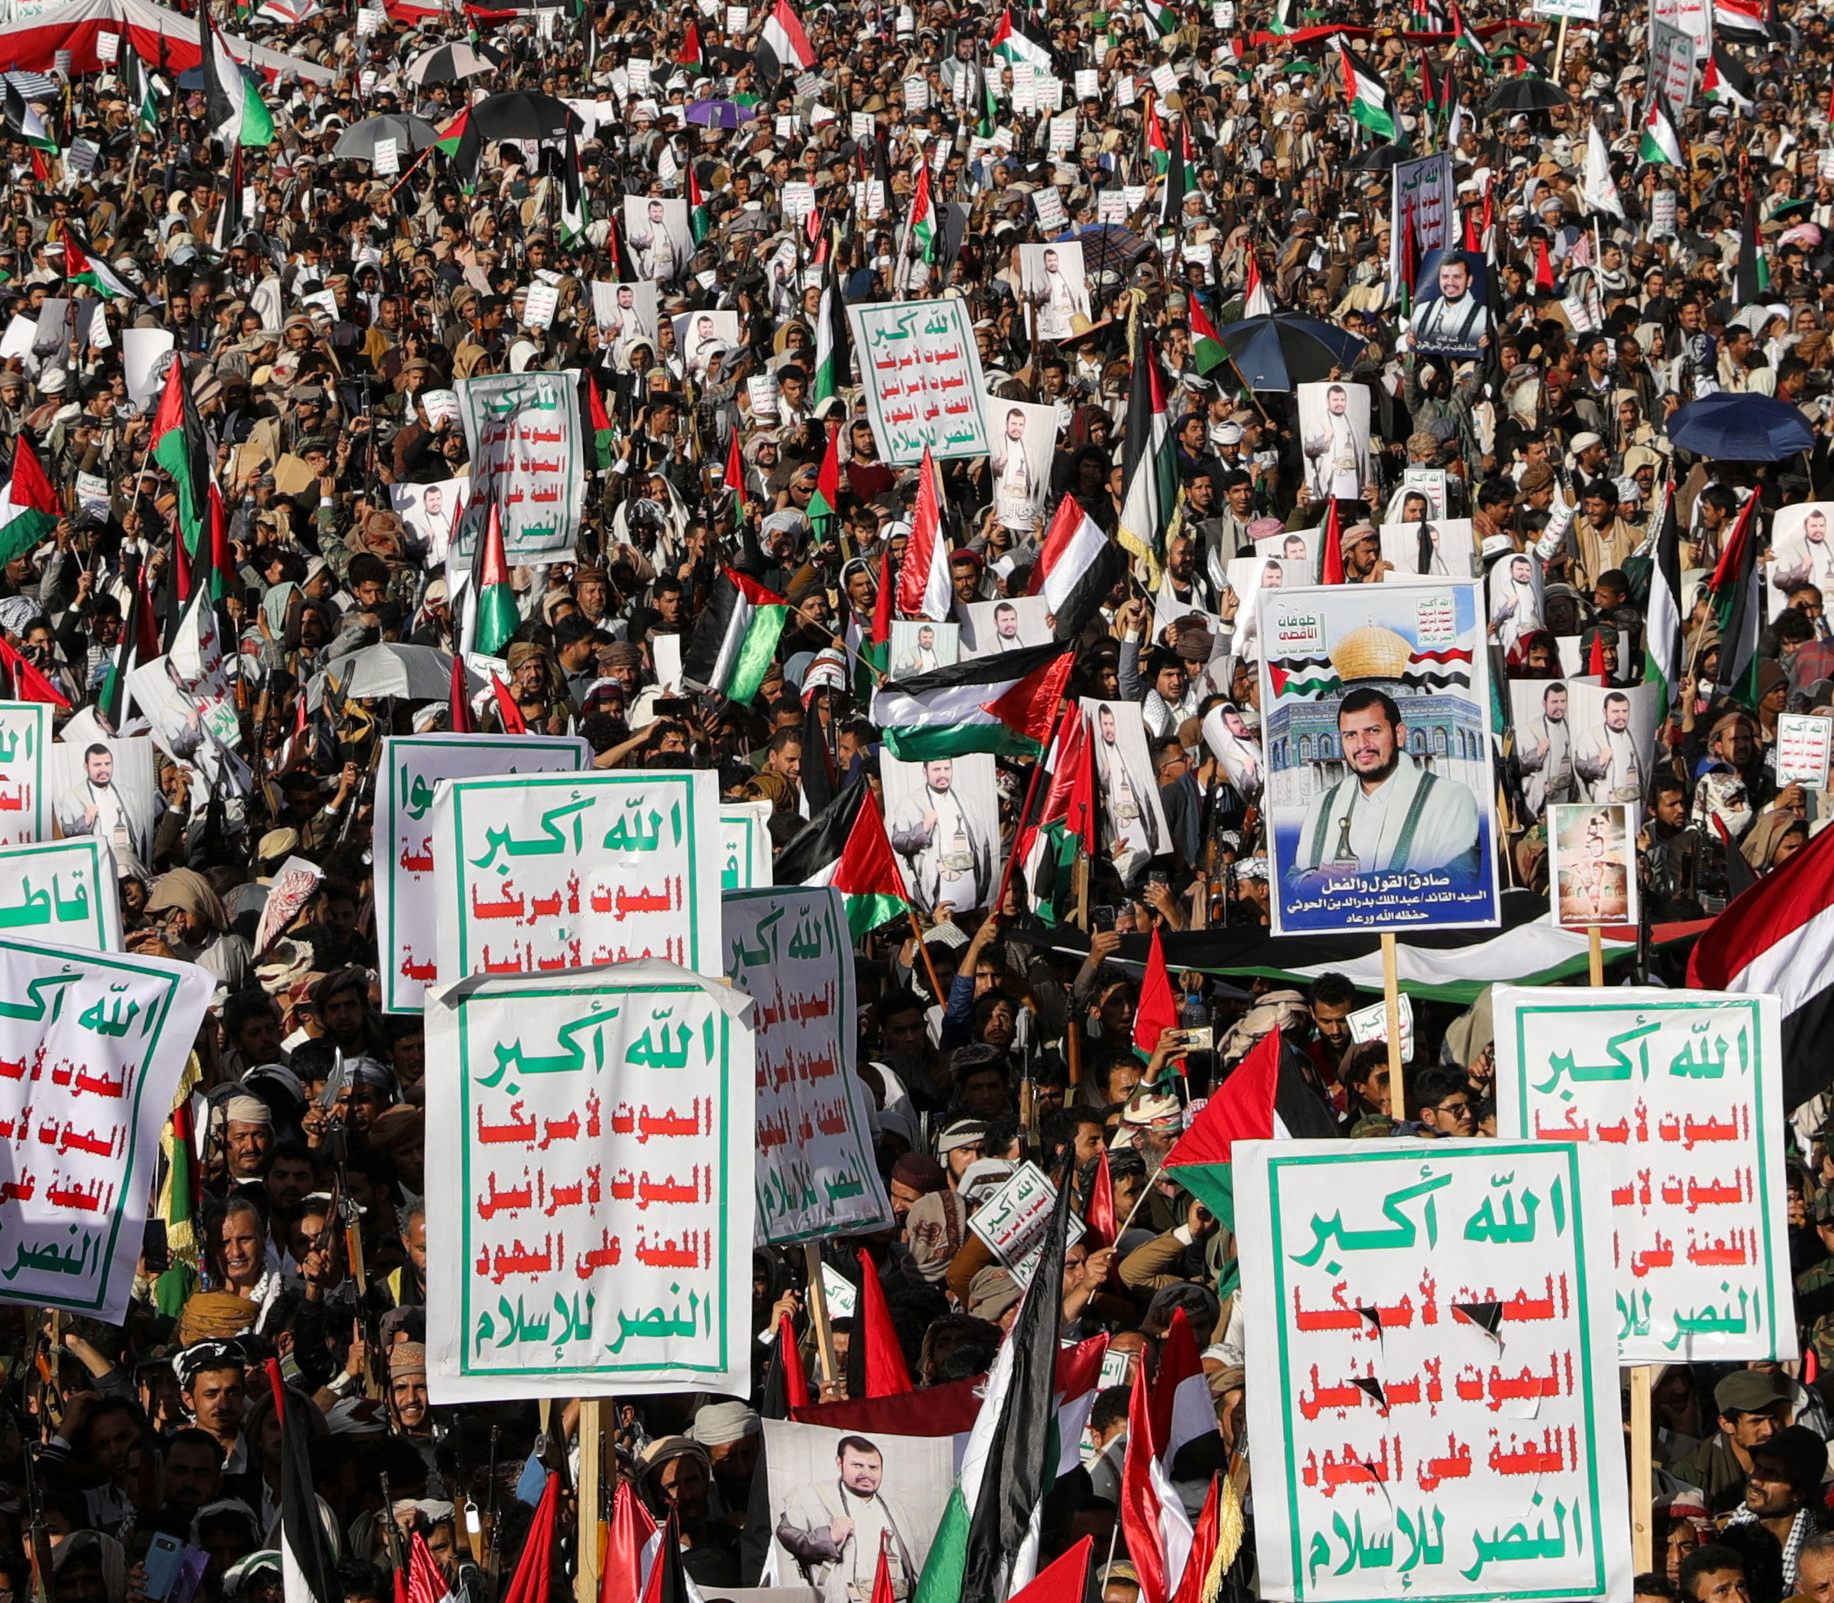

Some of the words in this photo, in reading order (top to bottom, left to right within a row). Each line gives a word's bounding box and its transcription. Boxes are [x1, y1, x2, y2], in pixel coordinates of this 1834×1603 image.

[1278, 614, 1317, 627] طوفان
[1279, 628, 1317, 641] الأقصى
[1287, 899, 1326, 913] الحوثي
[1322, 877, 1367, 894] والفعل
[1369, 875, 1407, 892] القول
[1409, 874, 1449, 890] صادق
[1458, 891, 1486, 902] السيد
[1376, 910, 1396, 920] الله
[1395, 910, 1428, 919] حفظه
[79, 986, 158, 1037] الله
[476, 1005, 619, 1095] أكبر
[625, 1009, 714, 1068] الله
[52, 1060, 133, 1098] الموت
[39, 1118, 125, 1157] الموت
[611, 1098, 711, 1143] الموت
[46, 1171, 113, 1212] اللعنة
[611, 1166, 711, 1210] الموت
[1464, 1173, 1565, 1243] الله
[1291, 1166, 1452, 1275] أكبر
[3, 1226, 105, 1280] النصر
[476, 1234, 564, 1284] اليهود
[576, 1229, 621, 1279] على
[636, 1226, 711, 1268] اللعنة
[476, 1294, 595, 1358] للإسلام
[607, 1283, 711, 1353] النصر
[1455, 1352, 1573, 1411] الموت
[1302, 1436, 1403, 1497] اليهود
[1417, 1434, 1472, 1492] على
[1489, 1426, 1577, 1475] اللعنة
[1309, 1508, 1445, 1588] للإسلام
[1462, 1493, 1583, 1581] النصر
